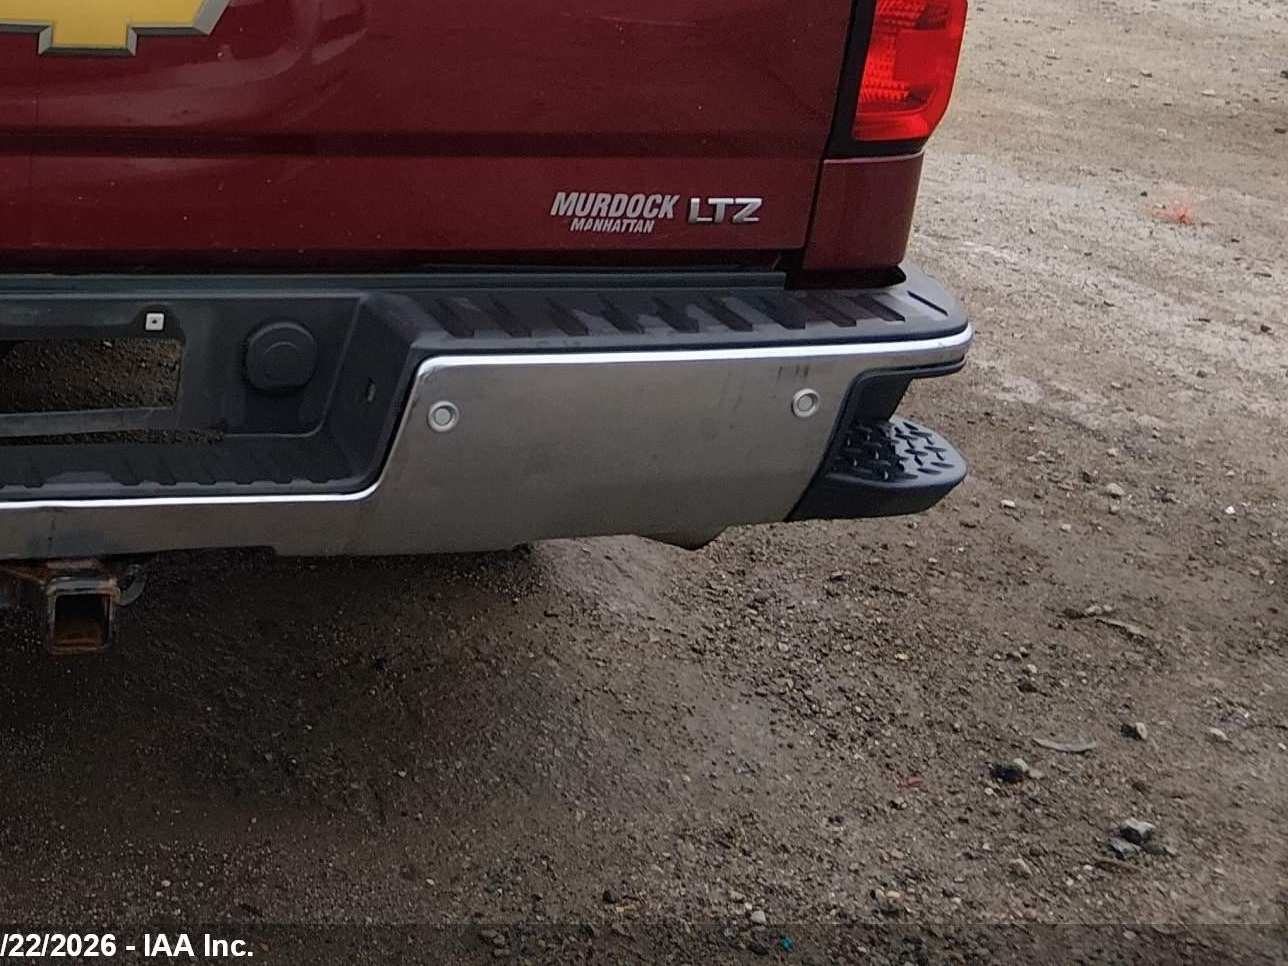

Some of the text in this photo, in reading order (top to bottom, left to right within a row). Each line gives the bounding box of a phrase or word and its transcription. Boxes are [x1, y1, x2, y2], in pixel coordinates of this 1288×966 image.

[550, 192, 763, 224] MURDOCK LTZ
[570, 218, 655, 234] MANHATTAN
